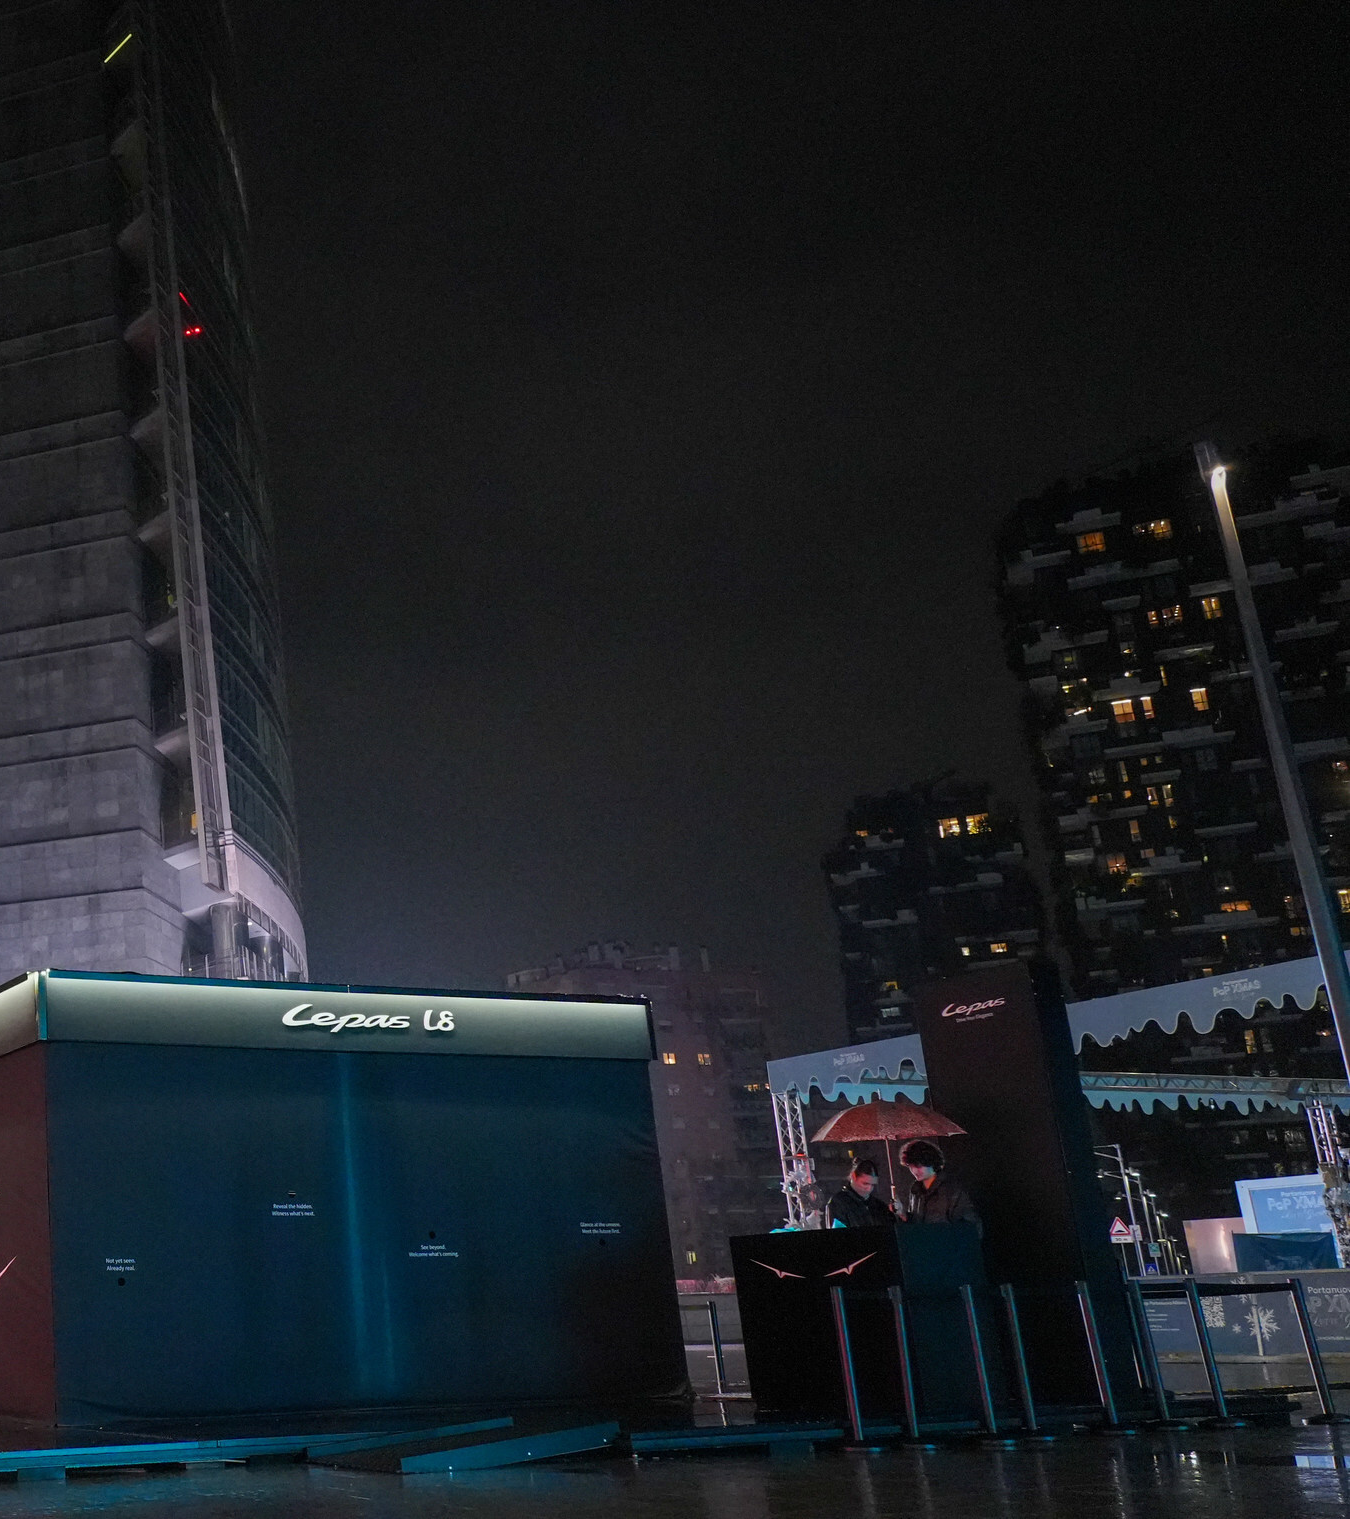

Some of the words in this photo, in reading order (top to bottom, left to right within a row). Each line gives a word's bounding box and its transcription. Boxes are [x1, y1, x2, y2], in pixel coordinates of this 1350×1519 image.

[282, 1003, 410, 1033] Lepas
[423, 1009, 455, 1032] L8
[941, 997, 1005, 1017] Lepas
